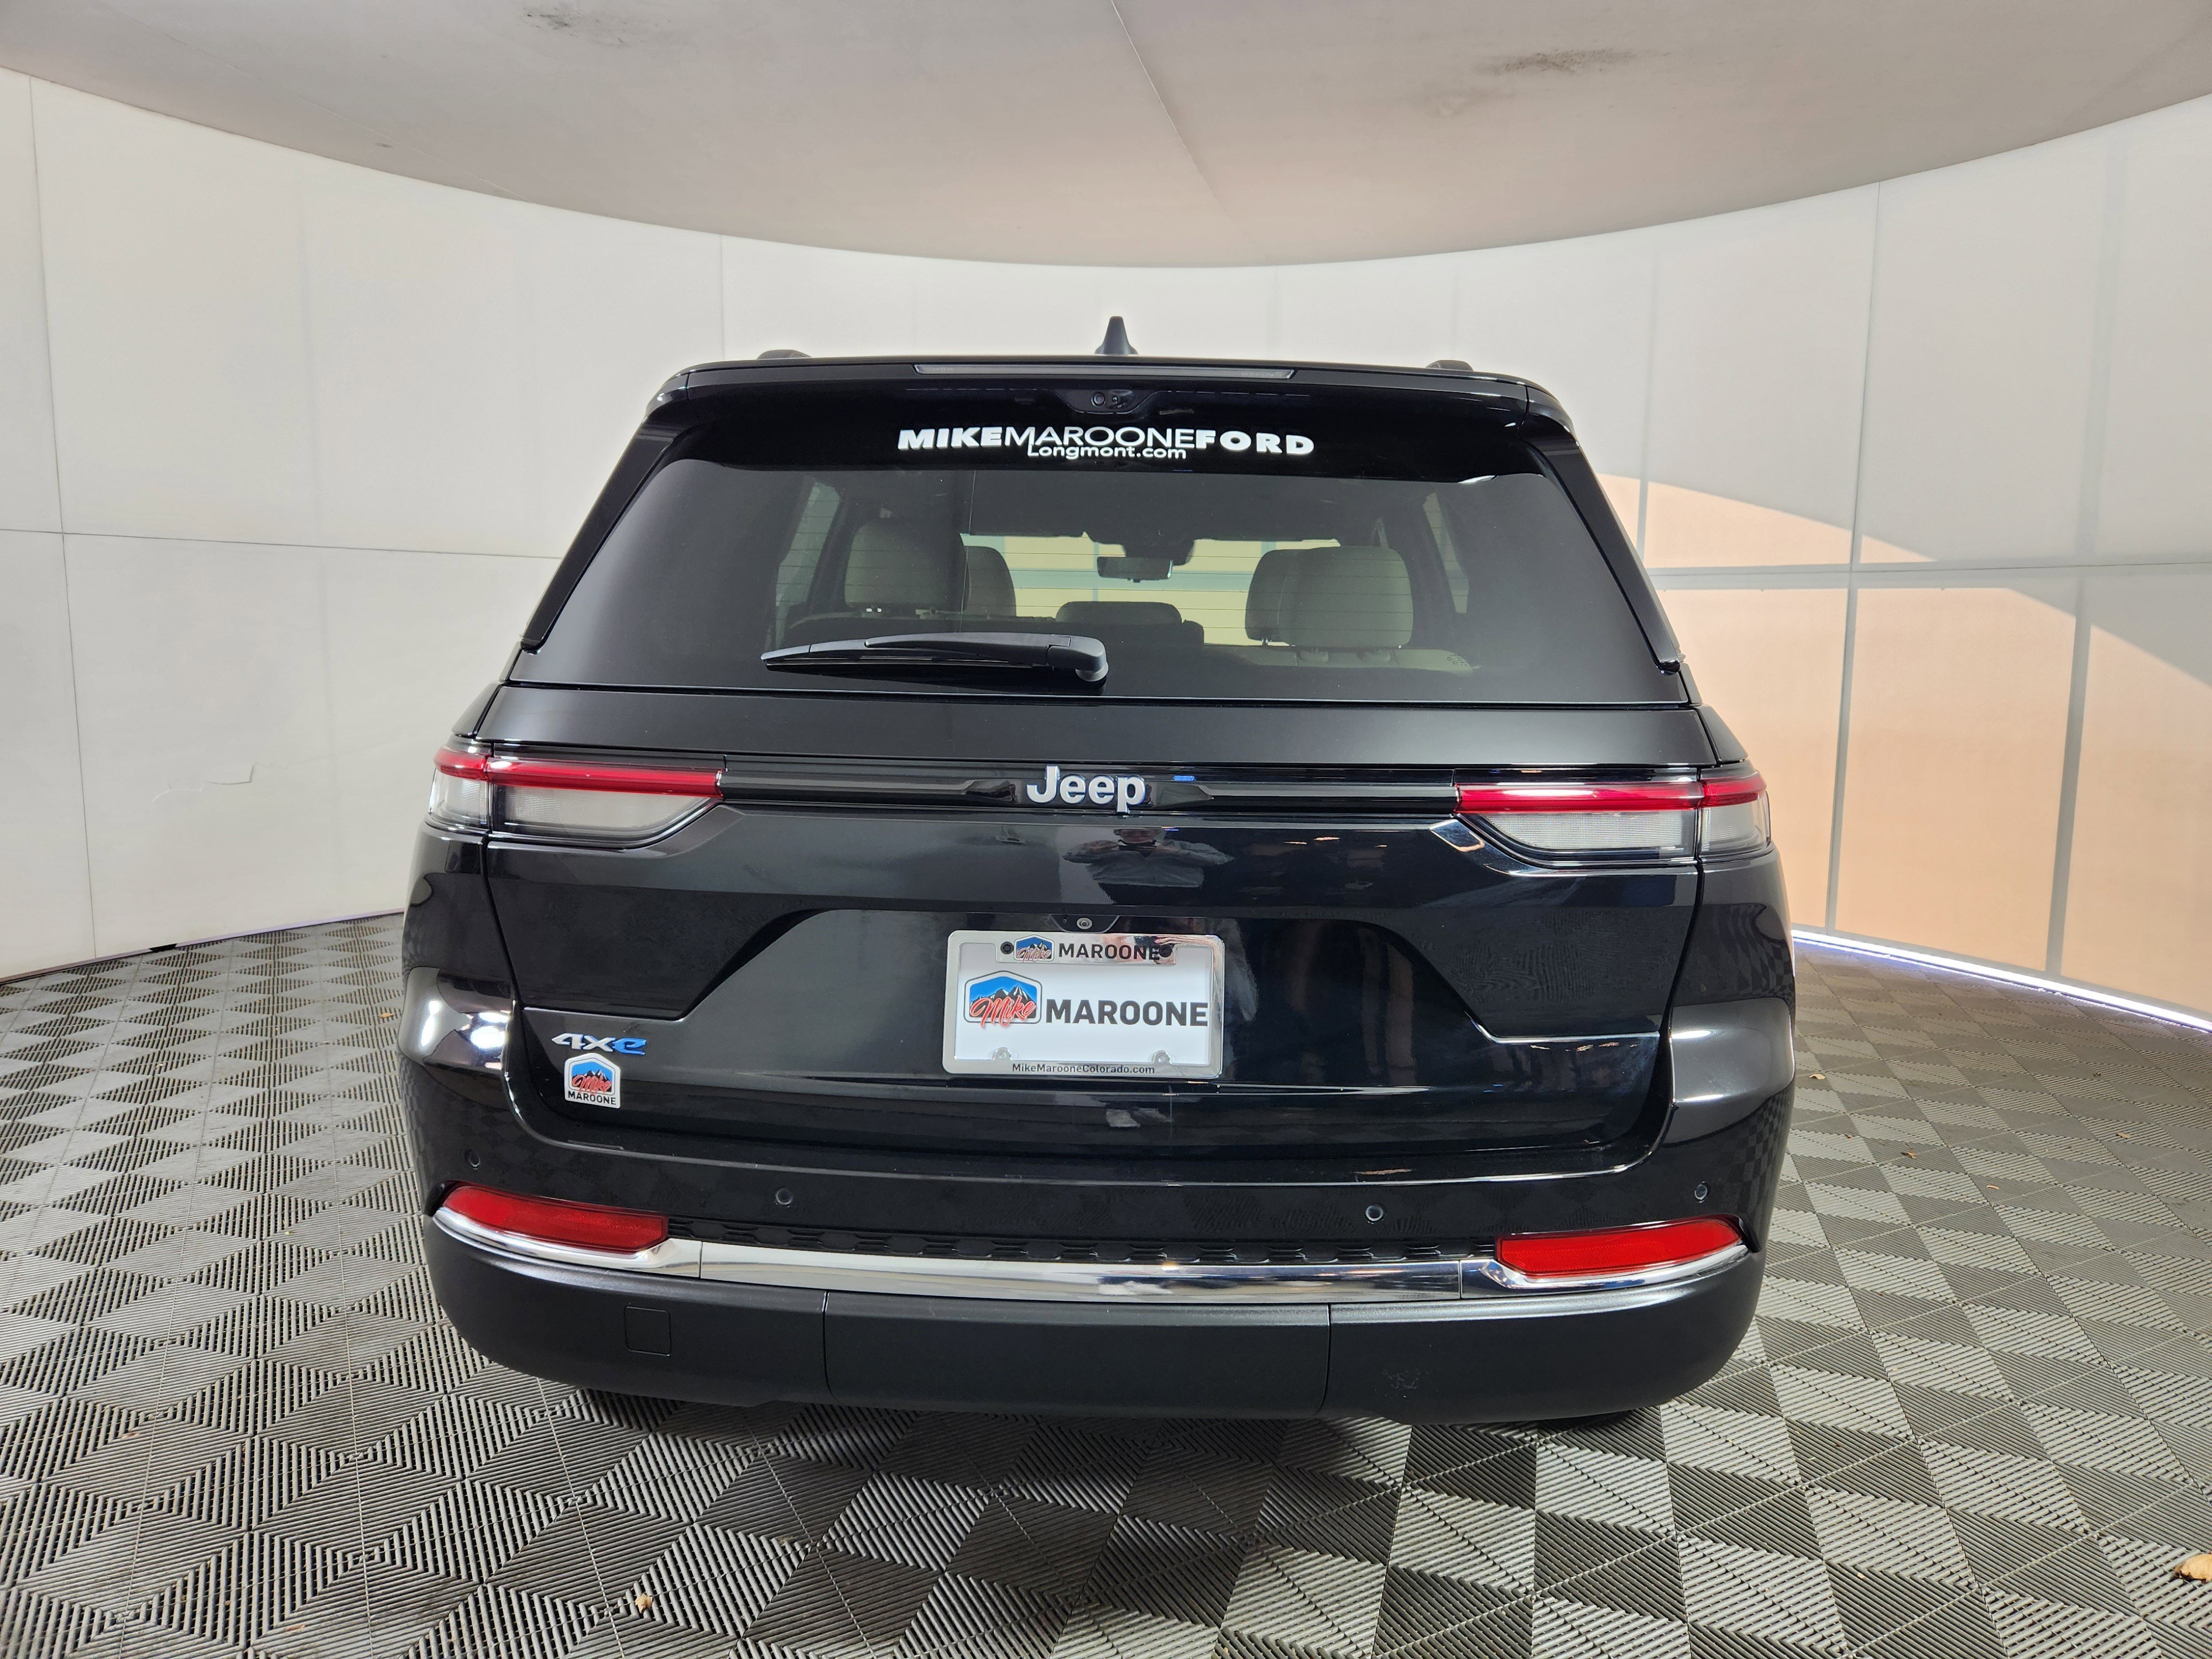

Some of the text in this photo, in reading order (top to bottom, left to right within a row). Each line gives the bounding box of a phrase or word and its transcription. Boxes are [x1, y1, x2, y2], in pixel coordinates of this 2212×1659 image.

[1027, 443, 1187, 460] Longmont.com
[1026, 765, 1146, 813] Jeep
[1015, 943, 1160, 962] Mike MAROONE
[969, 996, 1209, 1028] Mike MAROONE
[1012, 1063, 1155, 1074] MikeMarooneColorado.com
[571, 1074, 612, 1095] Mike
[568, 1091, 617, 1105] MAROONE
